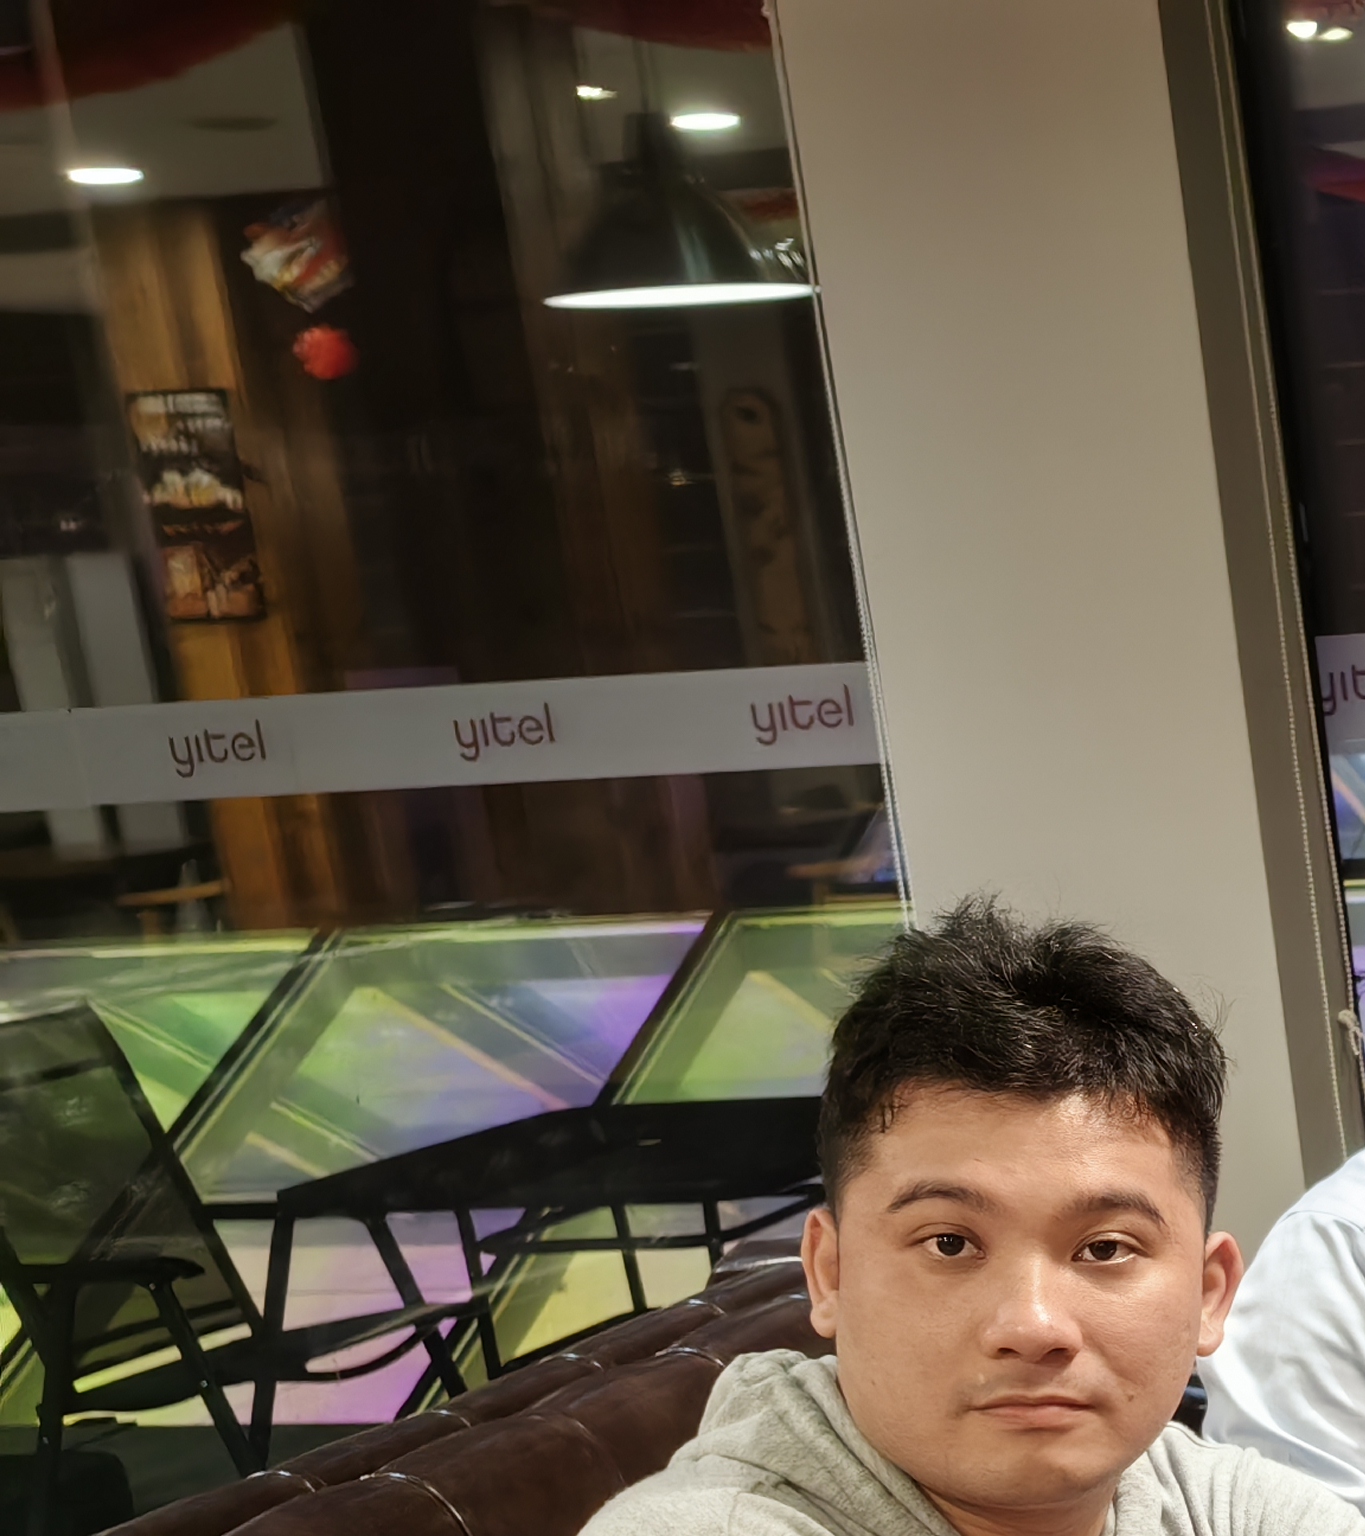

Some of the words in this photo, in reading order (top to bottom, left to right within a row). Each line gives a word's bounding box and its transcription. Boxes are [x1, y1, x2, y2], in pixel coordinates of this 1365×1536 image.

[167, 718, 267, 779] yitel
[452, 701, 557, 763] yitel
[749, 683, 855, 747] yitel
